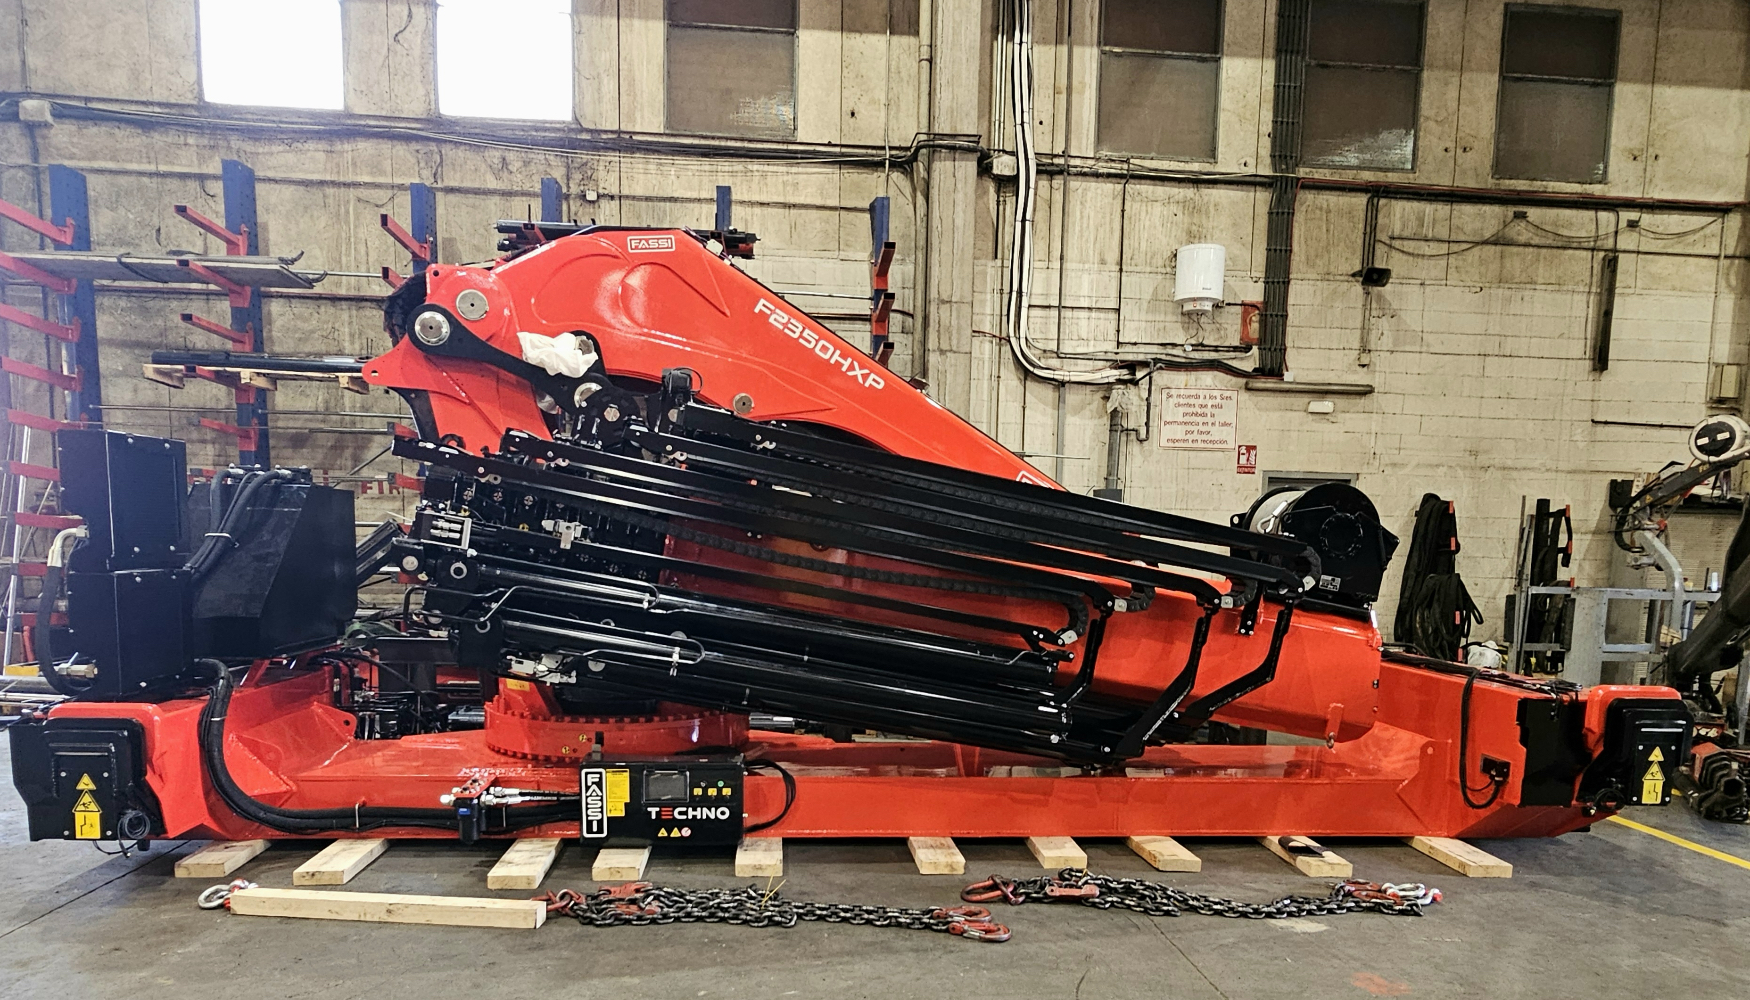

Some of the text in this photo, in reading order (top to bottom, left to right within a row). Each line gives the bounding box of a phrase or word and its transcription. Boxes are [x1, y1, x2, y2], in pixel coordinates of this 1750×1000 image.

[631, 238, 671, 249] FASSI
[753, 297, 885, 390] F2350HXP
[1166, 391, 1173, 399] Se
[1176, 392, 1200, 400] recuerda
[1209, 392, 1217, 400] los
[1220, 393, 1233, 401] Sres.
[1182, 411, 1208, 419] prohibida
[586, 773, 602, 832] FASSI
[647, 806, 730, 820] TECHNO
